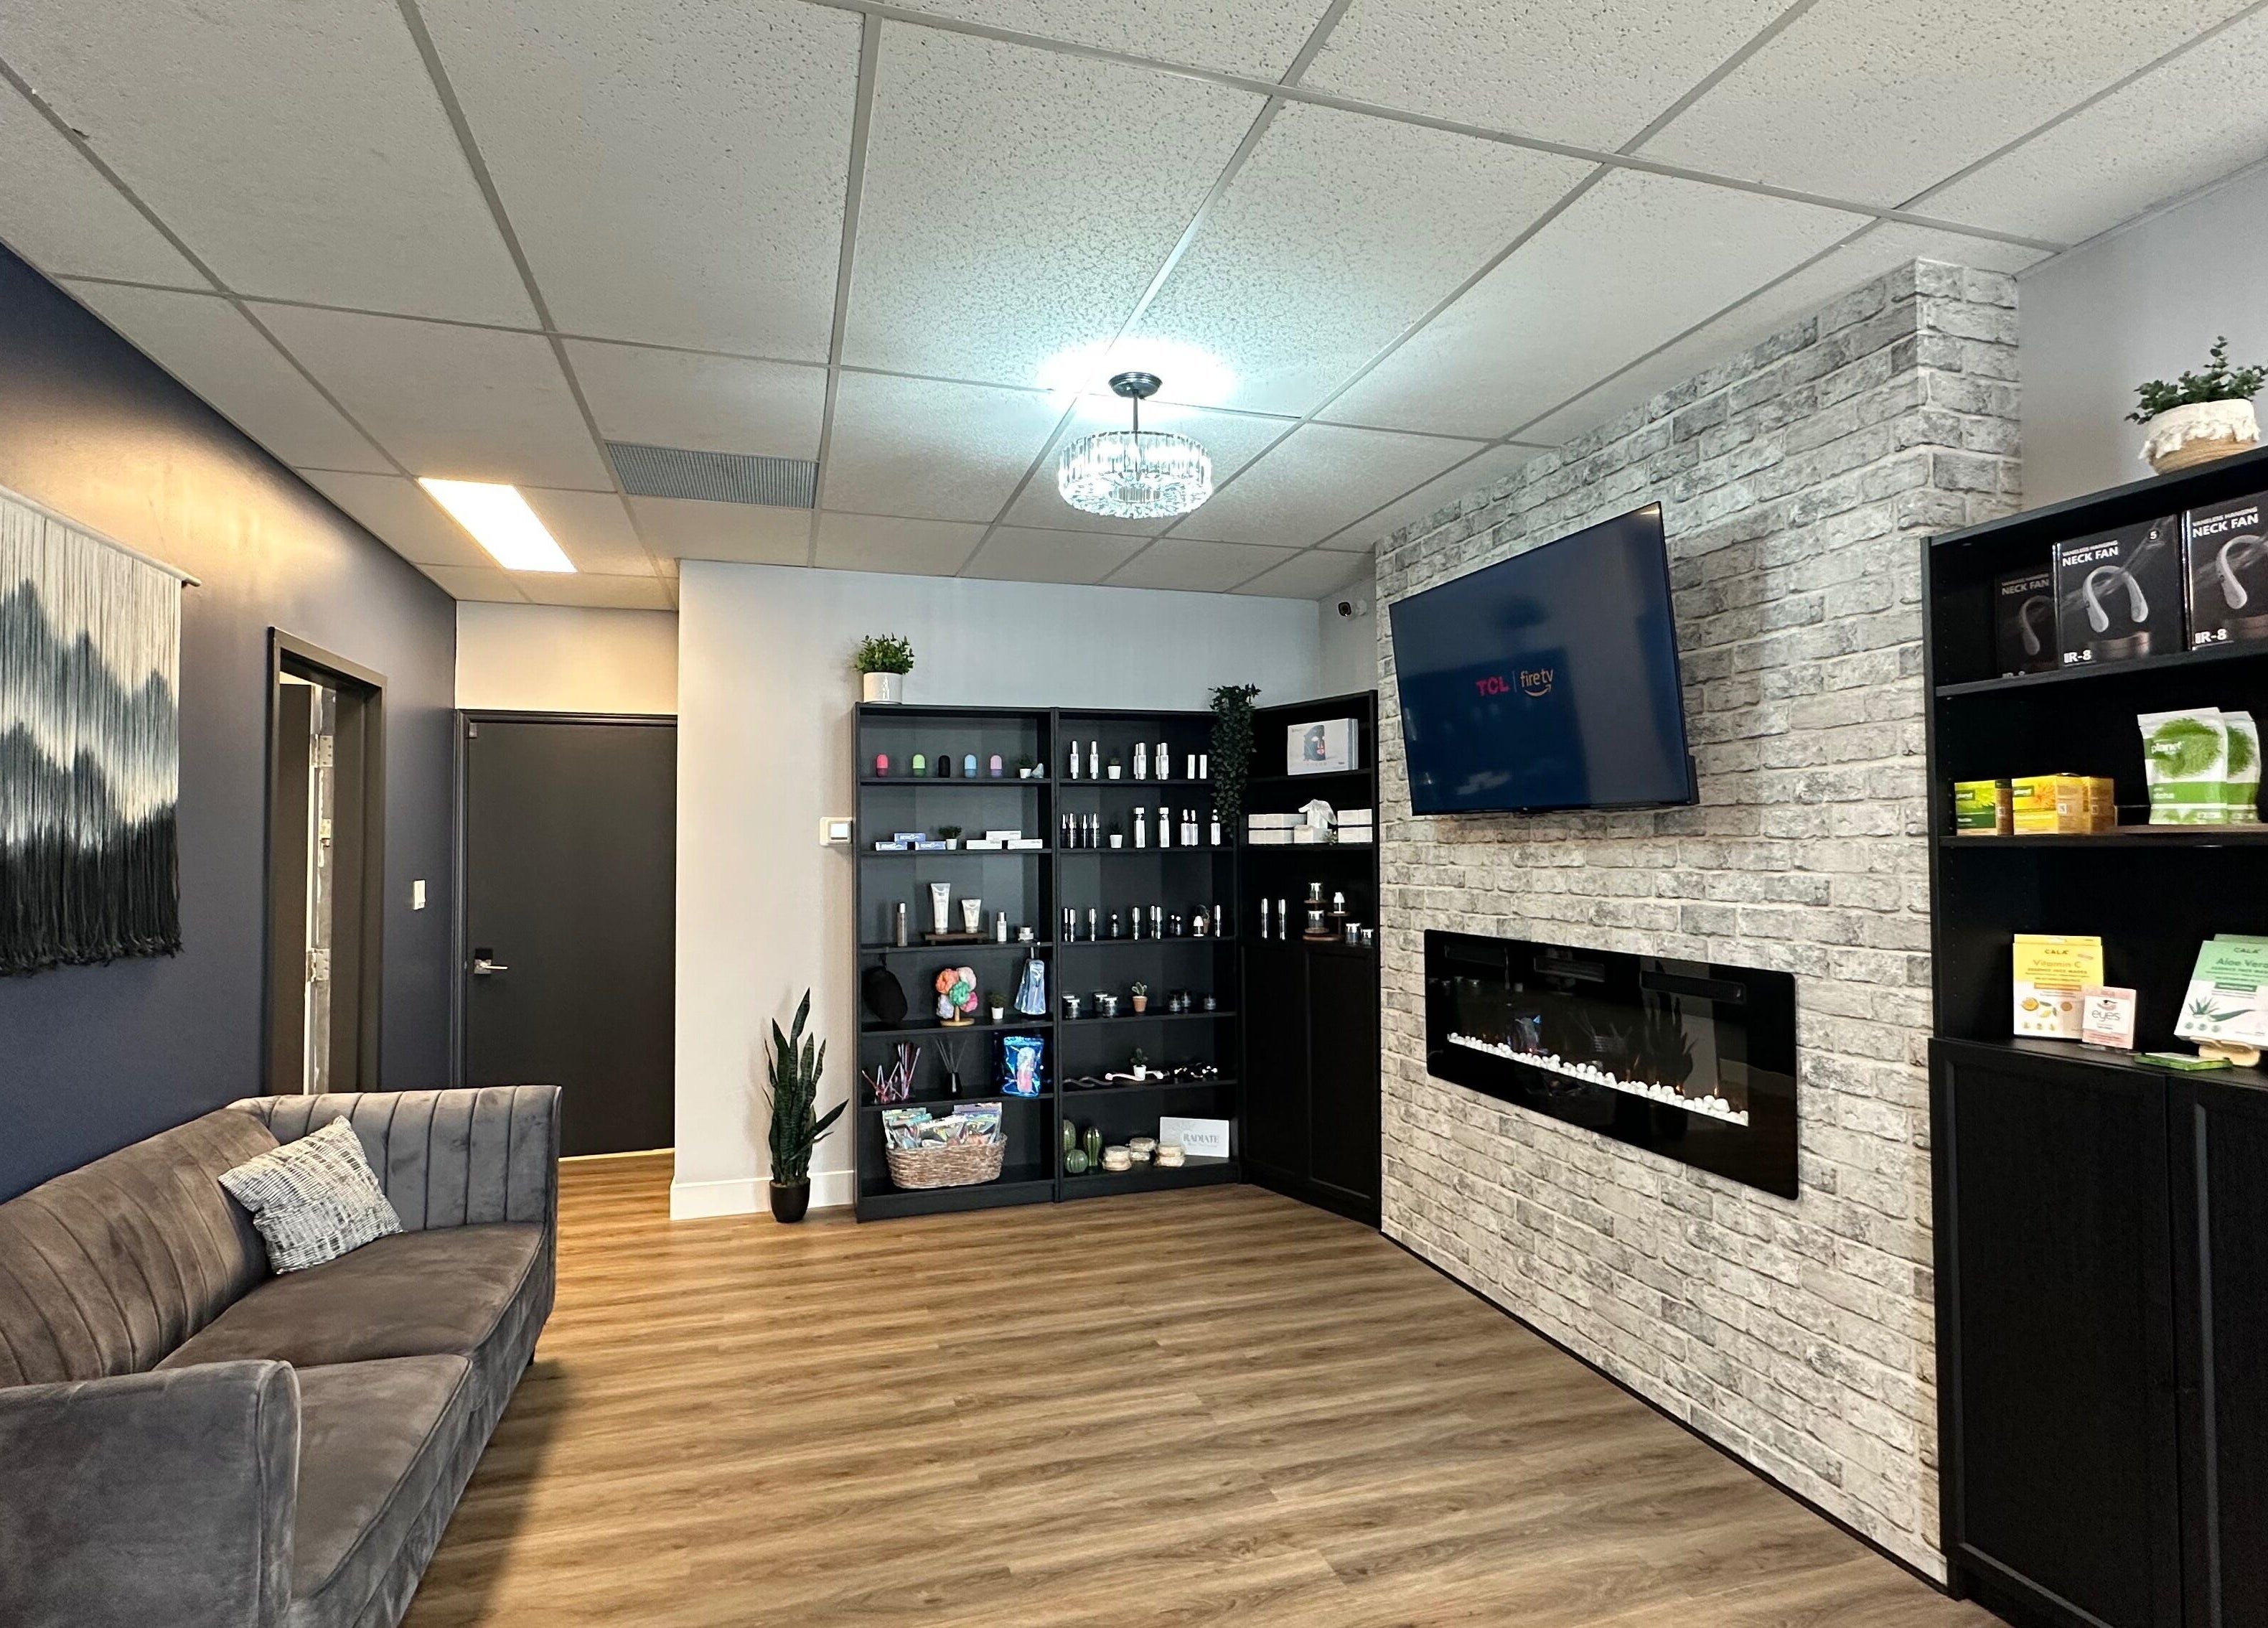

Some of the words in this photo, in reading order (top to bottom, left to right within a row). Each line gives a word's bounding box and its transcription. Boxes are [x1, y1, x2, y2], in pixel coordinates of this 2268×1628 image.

[2193, 520, 2228, 538] NECK
[2231, 513, 2259, 529] FAN
[2062, 552, 2093, 566] NECK
[2095, 546, 2119, 560] FAN
[2002, 583, 2028, 595] NECK
[2030, 579, 2049, 589] FAN
[1476, 676, 1511, 696] TCL
[2033, 959, 2071, 968] Vitamin
[2216, 958, 2241, 966] Aloe
[2091, 1010, 2121, 1022] eyes
